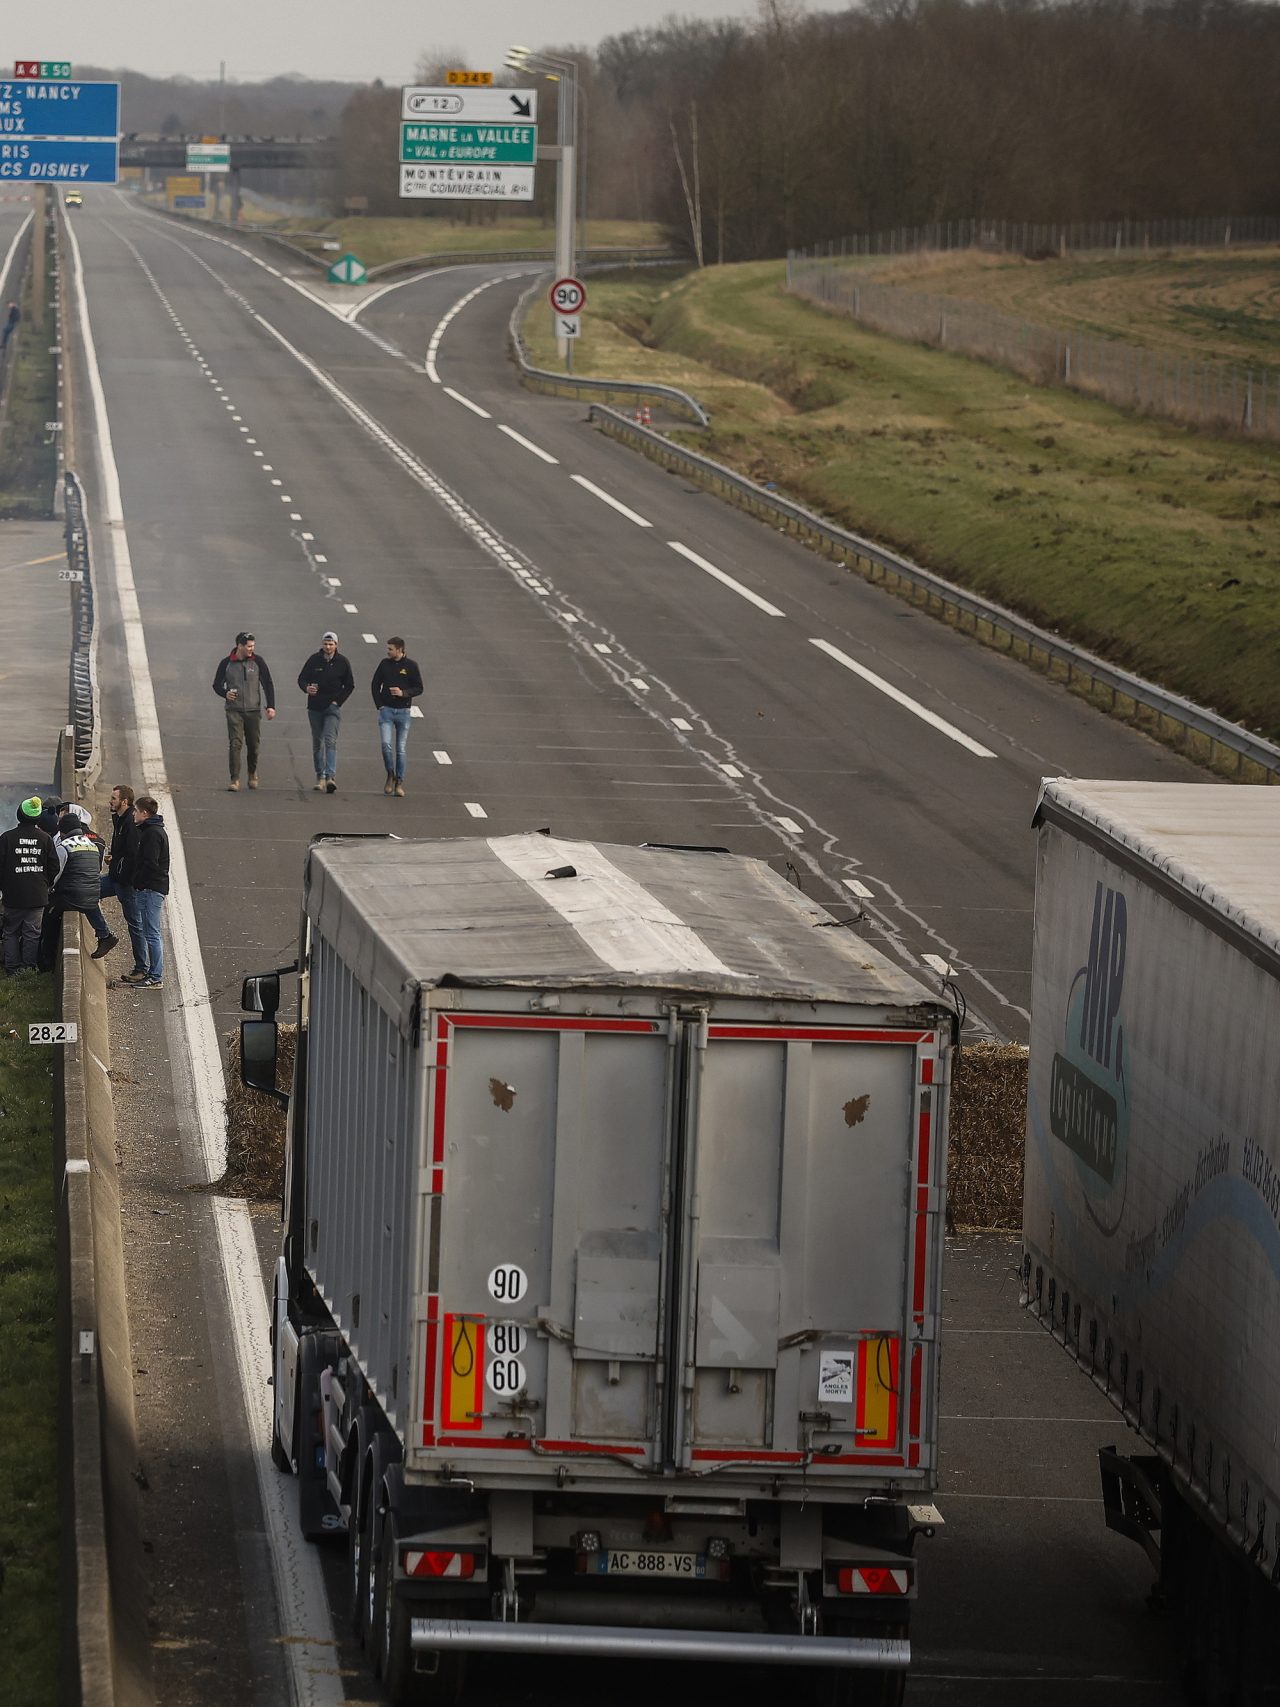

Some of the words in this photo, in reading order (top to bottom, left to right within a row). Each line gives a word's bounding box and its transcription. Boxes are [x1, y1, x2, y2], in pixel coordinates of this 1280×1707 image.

[16, 64, 25, 76] A
[29, 64, 38, 76] 4
[40, 64, 48, 76] E
[52, 64, 70, 76] 50
[26, 86, 81, 100] NANCY
[406, 128, 458, 141] MARNE
[477, 127, 530, 143] VALLÉE
[414, 146, 437, 158] VAL
[29, 163, 90, 177] DISNEY
[405, 168, 502, 180] MONTÉVRAIN
[429, 183, 506, 195] COMMERCIAL
[558, 290, 578, 303] 90
[31, 1026, 66, 1042] 28,2
[1051, 1061, 1117, 1165] logistique
[494, 1269, 520, 1299] 90
[494, 1325, 520, 1354] 80
[493, 1360, 519, 1391] 60
